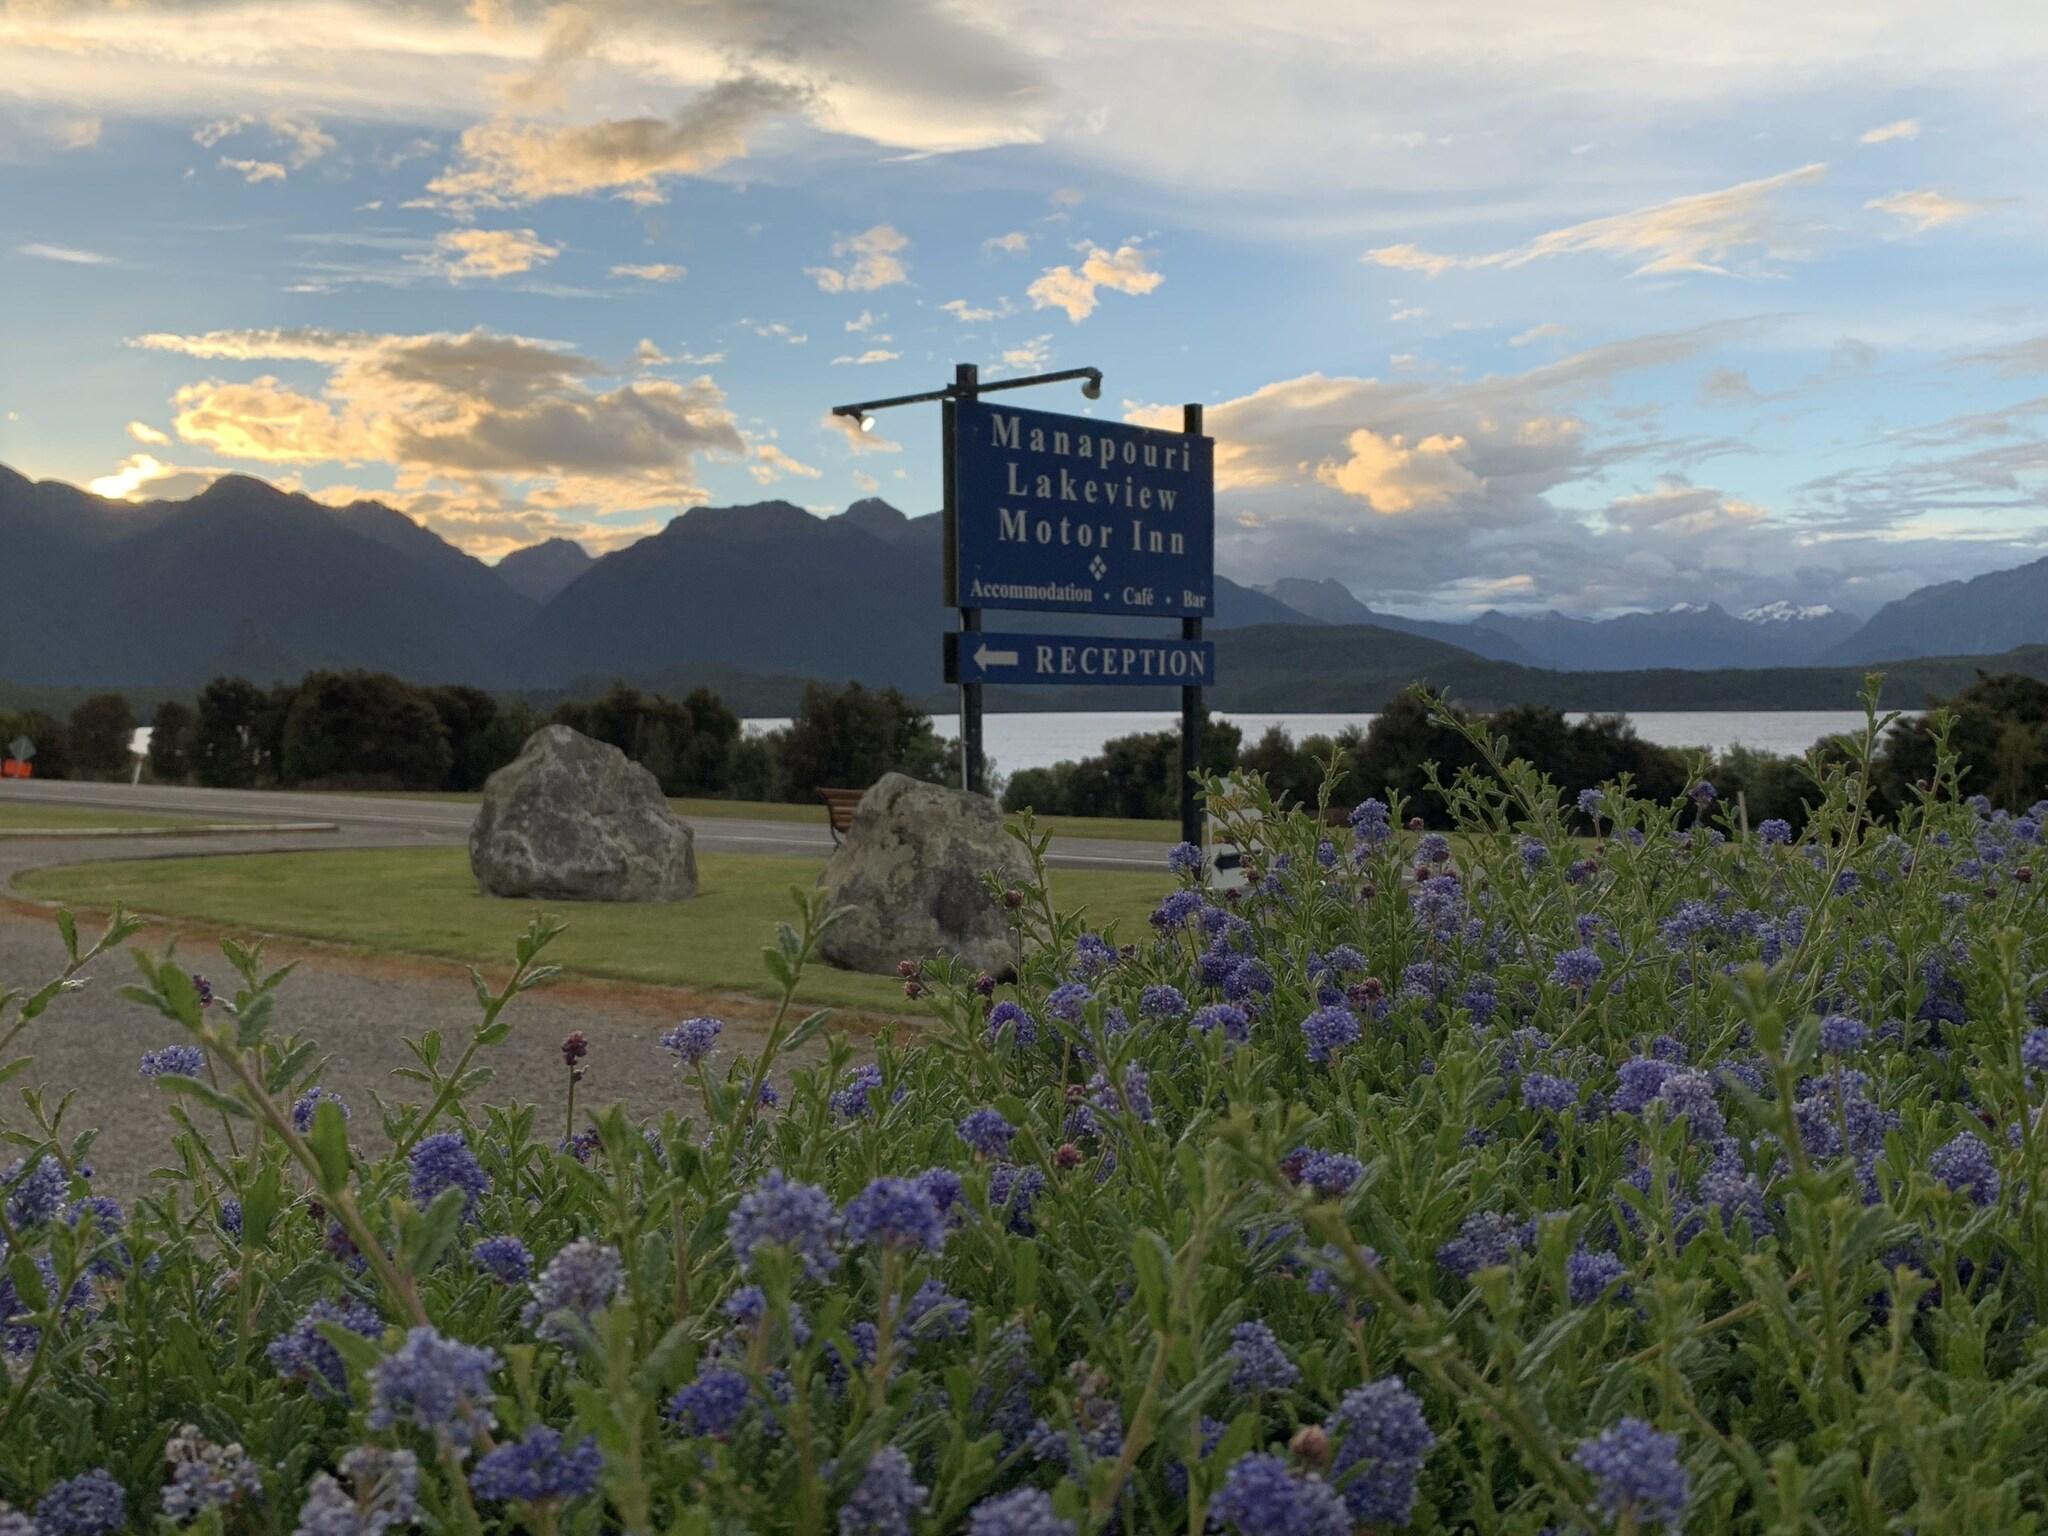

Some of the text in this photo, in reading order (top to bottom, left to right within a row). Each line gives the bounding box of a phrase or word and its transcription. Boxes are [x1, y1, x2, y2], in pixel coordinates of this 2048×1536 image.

[991, 413, 1191, 472] Manapouri
[1006, 462, 1177, 512] Lakeview
[999, 507, 1184, 554] Motor Inn
[970, 578, 1207, 608] Accommodation Café Bar
[1036, 645, 1206, 676] RECEPTION
